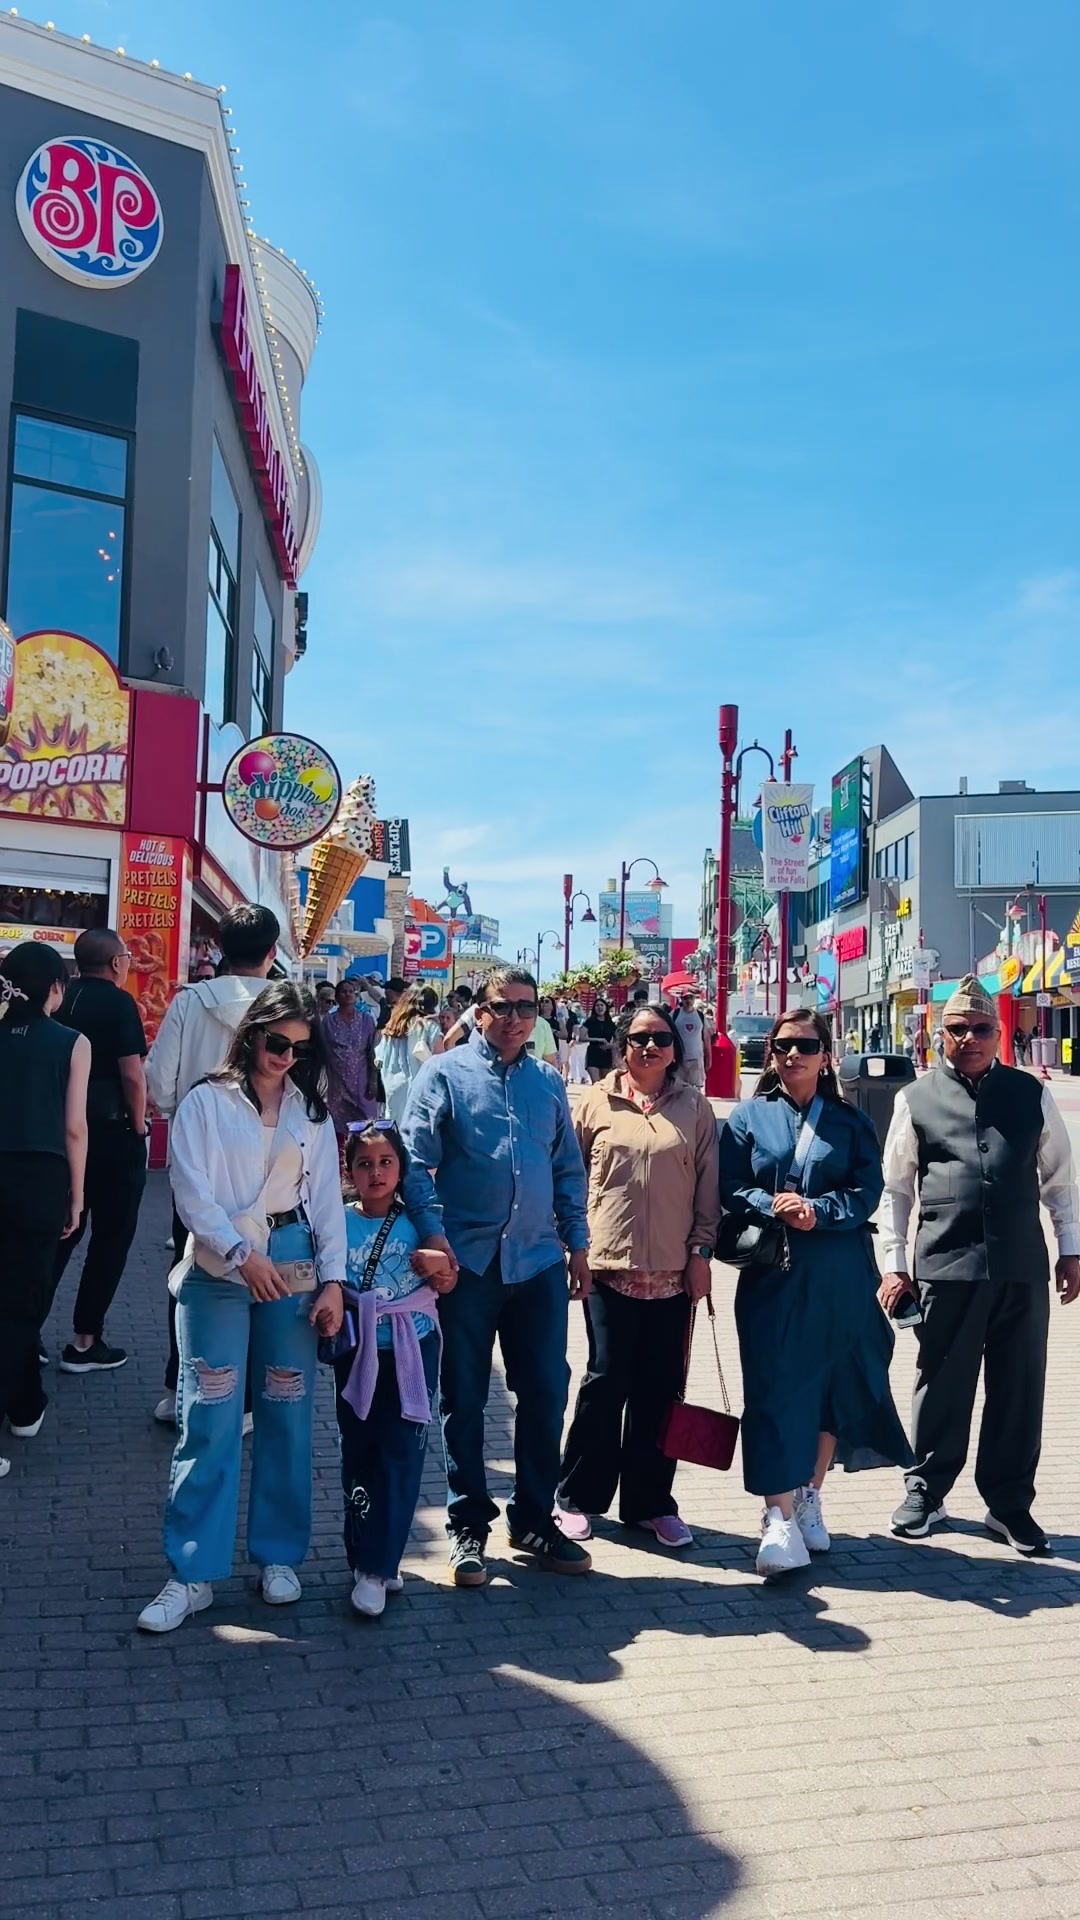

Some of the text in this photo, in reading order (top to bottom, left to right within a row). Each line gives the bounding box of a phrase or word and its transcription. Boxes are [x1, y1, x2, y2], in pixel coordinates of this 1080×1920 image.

[32, 144, 156, 255] BP
[0, 755, 125, 790] POPCORN
[769, 804, 808, 822] Clifton
[780, 820, 804, 837] Hill
[139, 840, 165, 852] HOT &
[375, 822, 384, 859] Believe
[129, 850, 175, 866] DELICIOUS
[770, 858, 804, 867] The Street
[124, 870, 177, 886] PRETZELS
[786, 868, 796, 876] fun
[769, 876, 805, 885] at the Falls
[123, 888, 177, 910] PRETZELS
[122, 912, 175, 928] PRETZELS
[421, 930, 440, 951] P
[421, 969, 442, 977] arking
[371, 1235, 386, 1260] YOUNG
